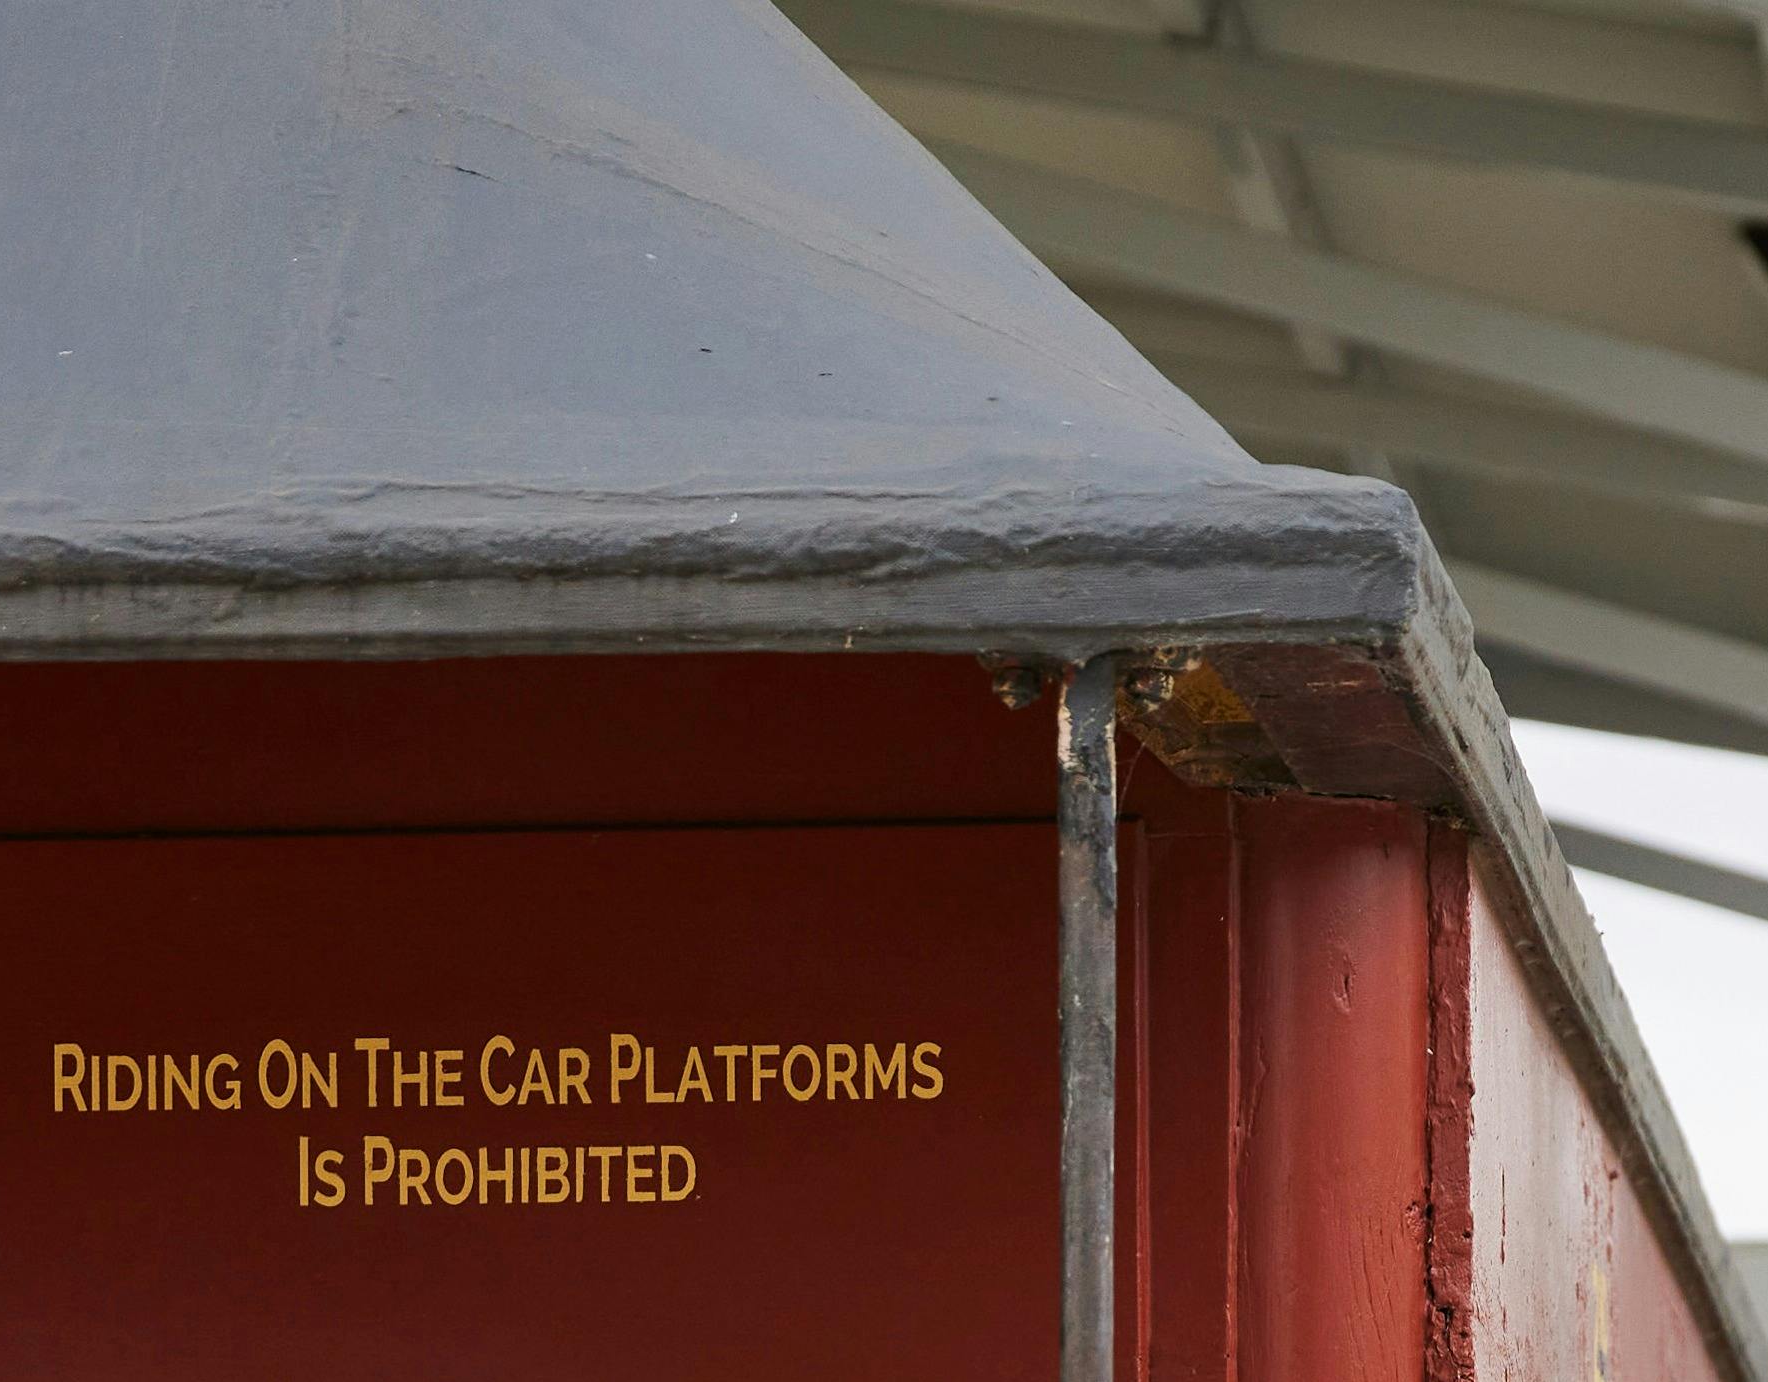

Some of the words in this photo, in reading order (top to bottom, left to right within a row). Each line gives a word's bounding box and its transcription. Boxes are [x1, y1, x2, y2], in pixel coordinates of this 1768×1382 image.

[53, 1043, 242, 1112] RIDING
[258, 1038, 338, 1109] ON
[354, 1037, 465, 1108] THE
[480, 1034, 592, 1106] CAR
[610, 1033, 944, 1104] PLATFORMS
[363, 1135, 697, 1206] PROHIBITED
